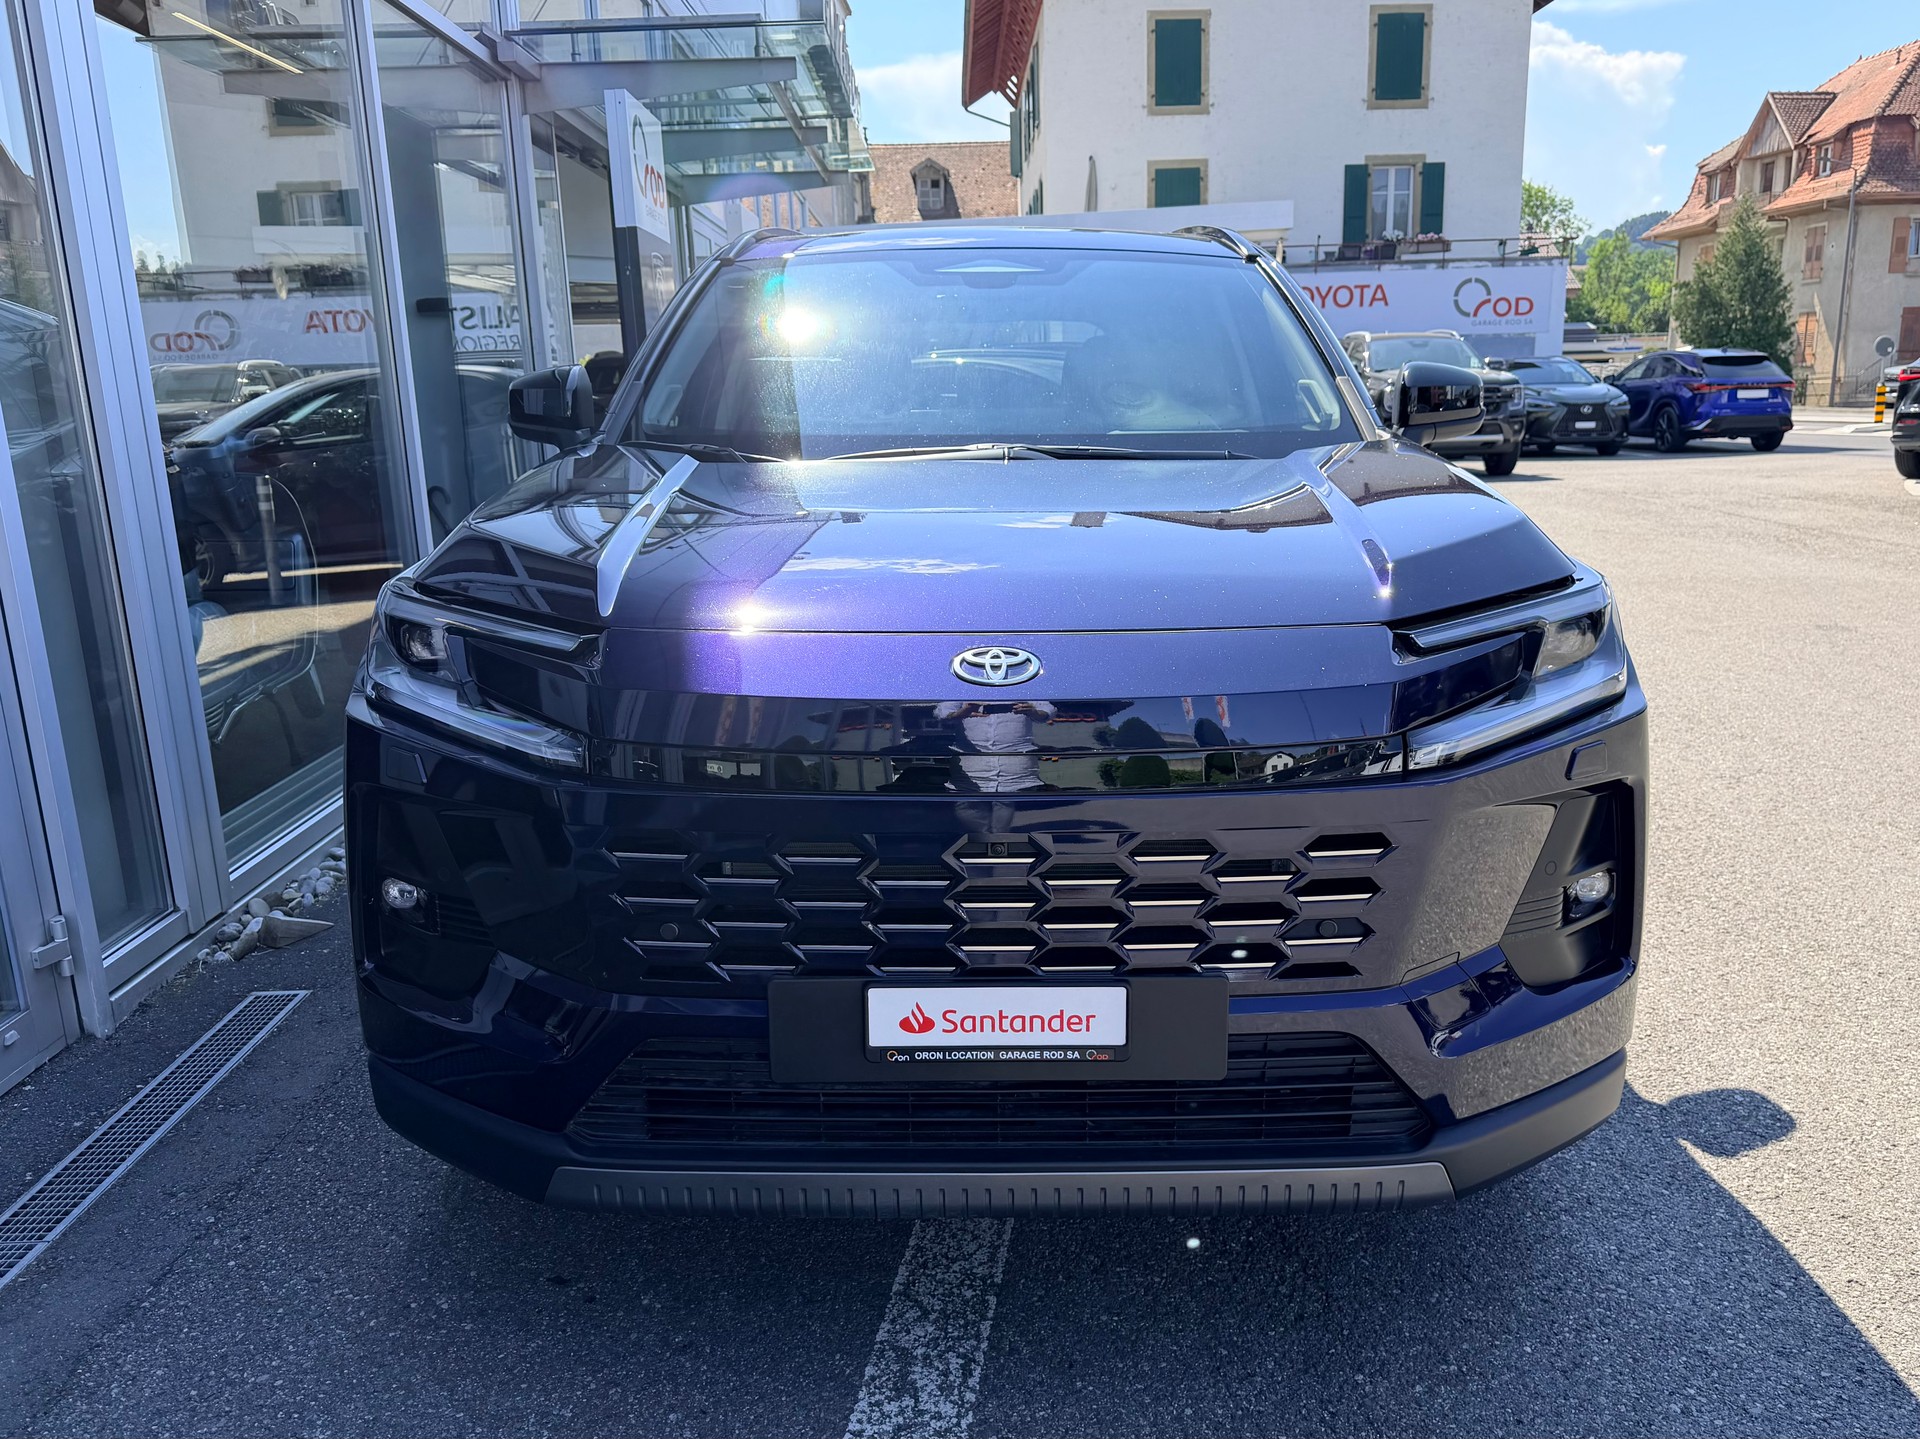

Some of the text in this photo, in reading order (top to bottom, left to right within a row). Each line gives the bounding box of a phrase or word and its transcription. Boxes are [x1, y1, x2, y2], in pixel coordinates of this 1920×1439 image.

[1471, 319, 1503, 327] GARAGE
[942, 1009, 1097, 1034] Santander
[915, 1051, 943, 1060] ORON
[946, 1051, 994, 1060] LOCATION
[999, 1051, 1041, 1059] GARAGE
[1043, 1051, 1065, 1059] ROD
[1066, 1051, 1080, 1059] SA
